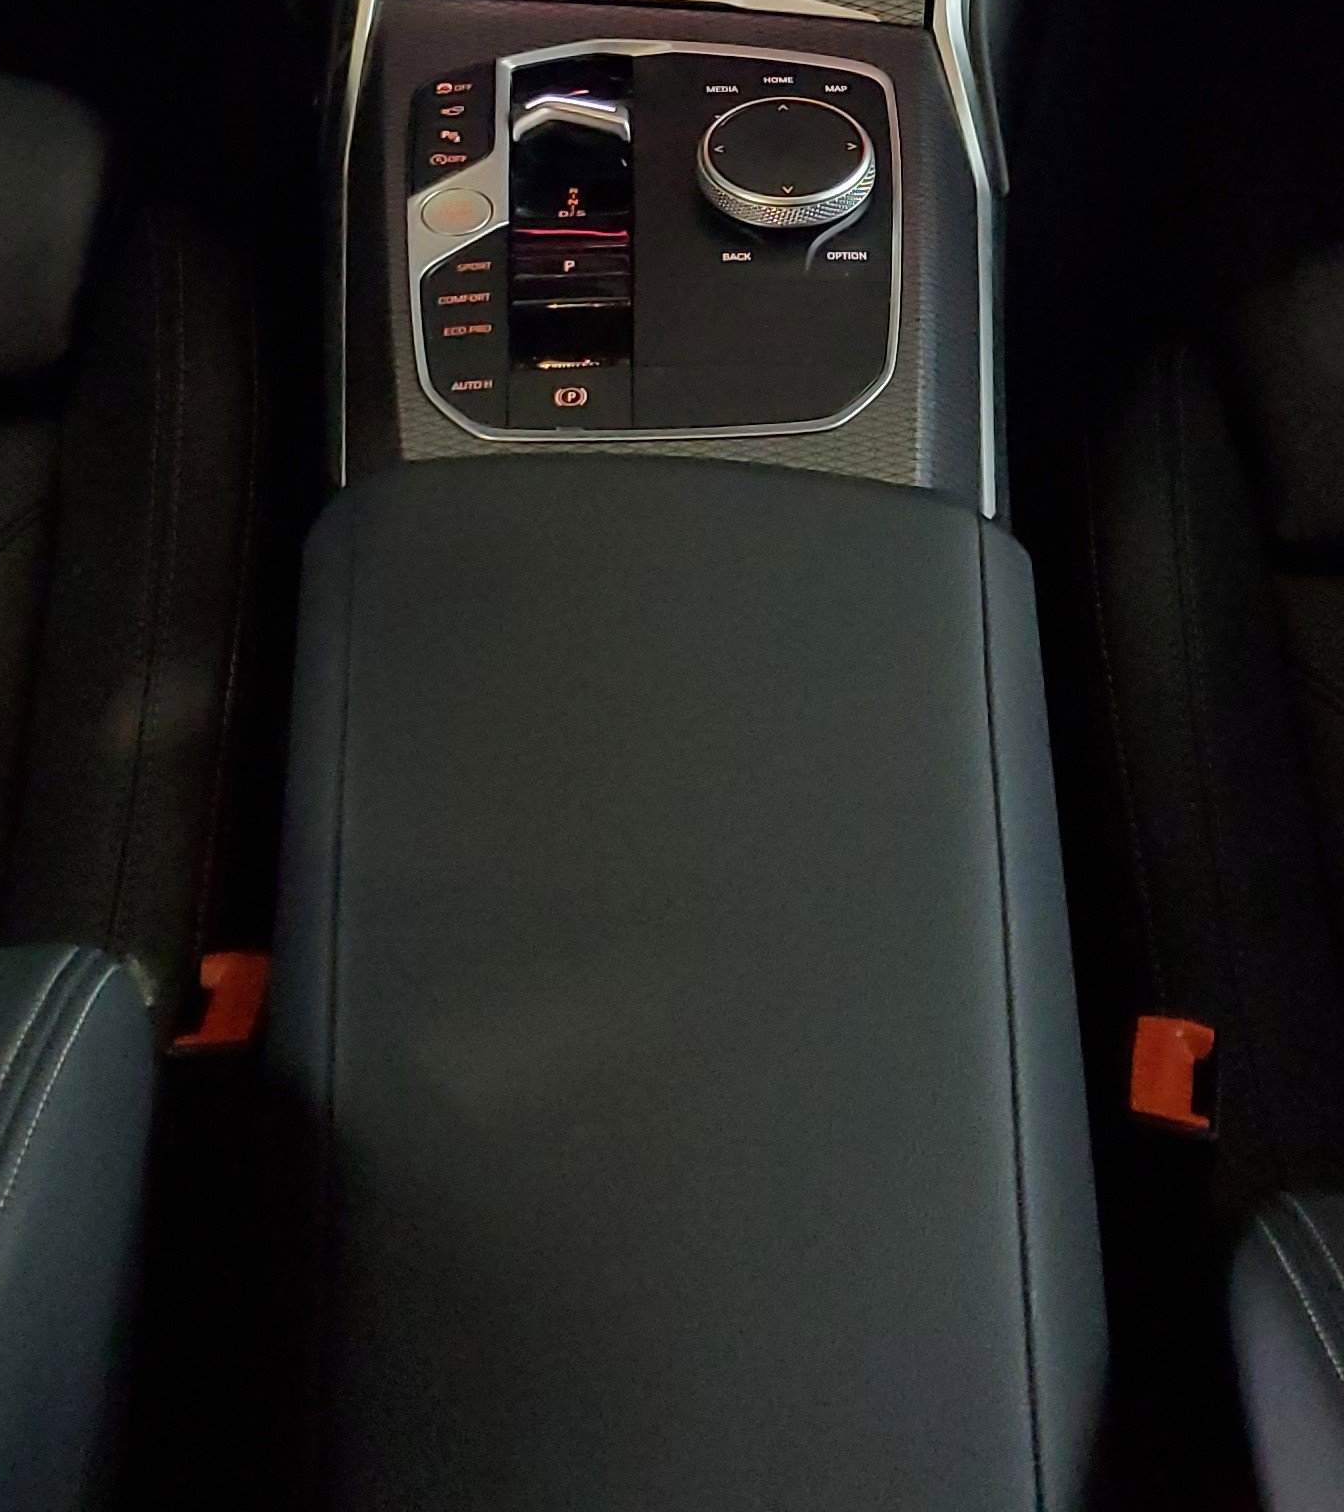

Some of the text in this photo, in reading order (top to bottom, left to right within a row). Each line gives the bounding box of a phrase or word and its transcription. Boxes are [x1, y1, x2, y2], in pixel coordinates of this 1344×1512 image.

[763, 76, 795, 85] HOME
[706, 85, 739, 94] MEDIA
[825, 85, 848, 93] MAP
[722, 252, 751, 262] BACK
[826, 251, 867, 261] OPTION
[457, 261, 492, 272] SPORT
[563, 260, 576, 272] P
[438, 292, 490, 305] COMFORT
[443, 326, 467, 337] ECO
[452, 380, 482, 391] AUTO
